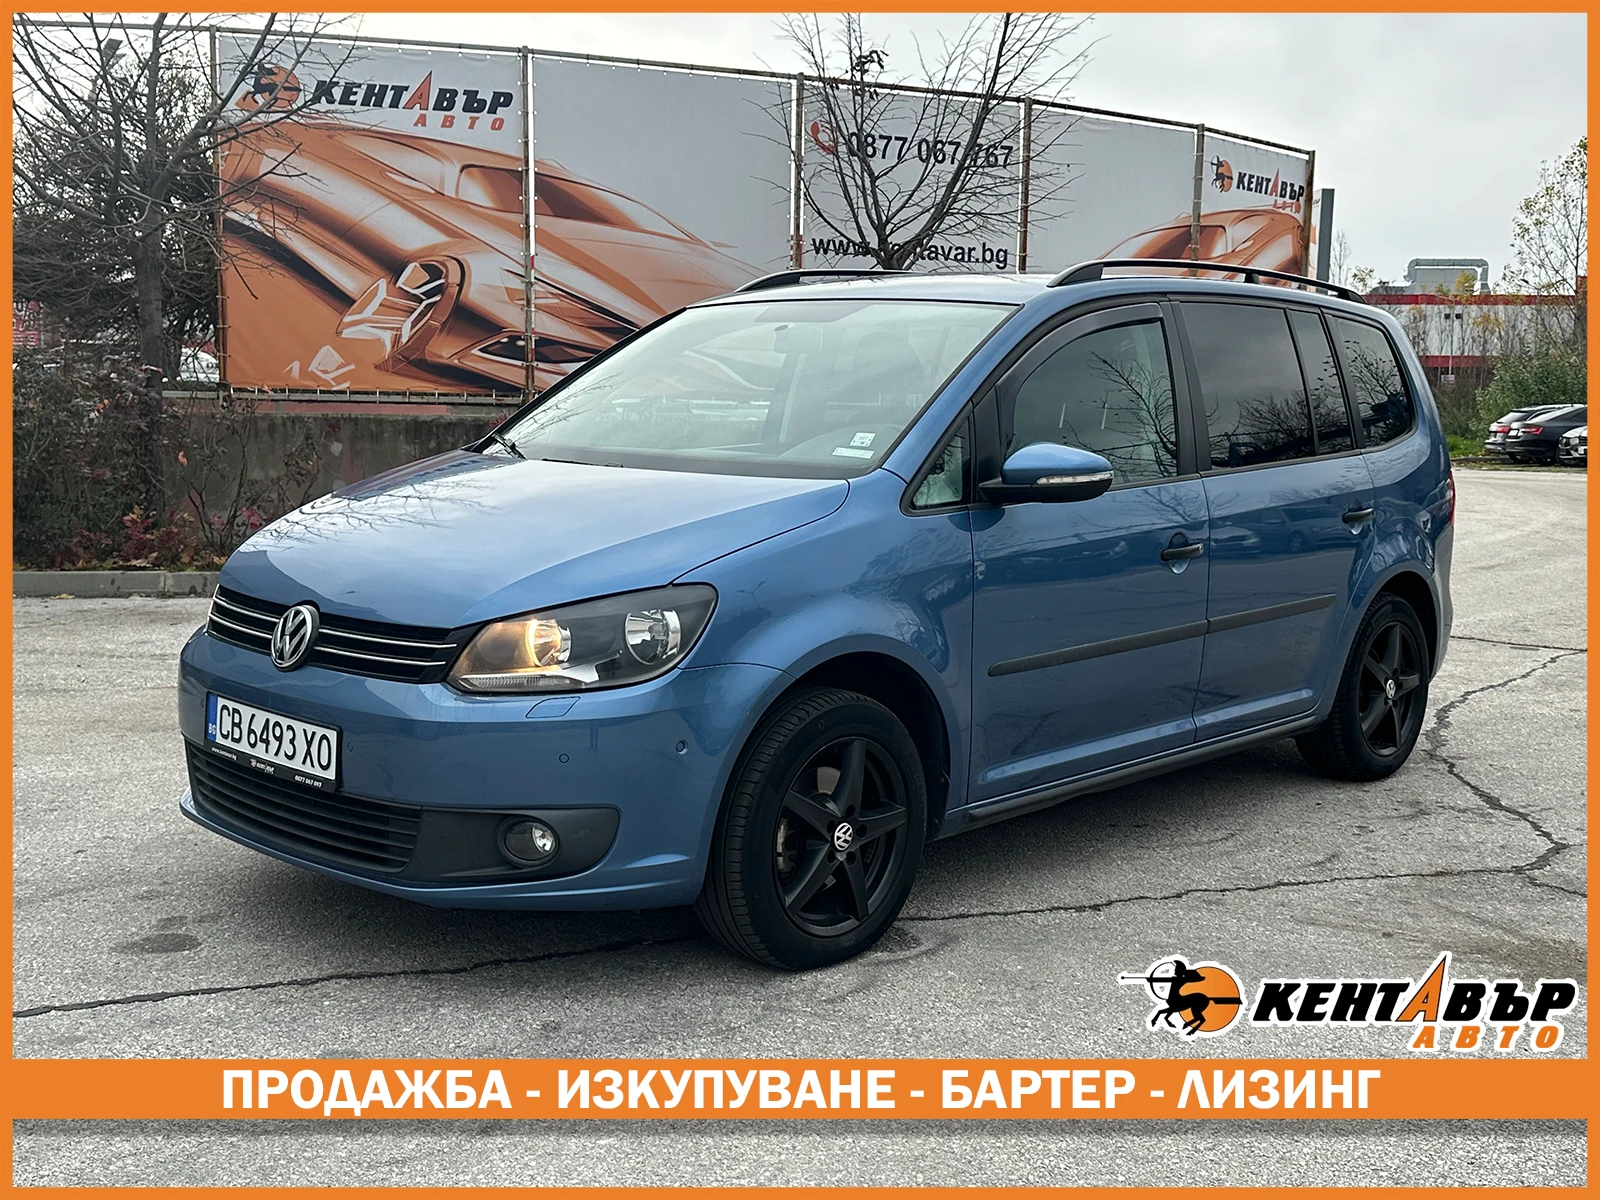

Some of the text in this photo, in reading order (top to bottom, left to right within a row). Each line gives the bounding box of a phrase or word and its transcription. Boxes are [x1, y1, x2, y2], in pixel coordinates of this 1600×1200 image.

[314, 70, 514, 115] КЕНТАВЪР
[413, 114, 505, 131] АВТО
[849, 132, 908, 161] 0877
[1236, 168, 1305, 201] КЕНТАВЪР
[208, 723, 217, 735] BG
[247, 713, 297, 761] 6493
